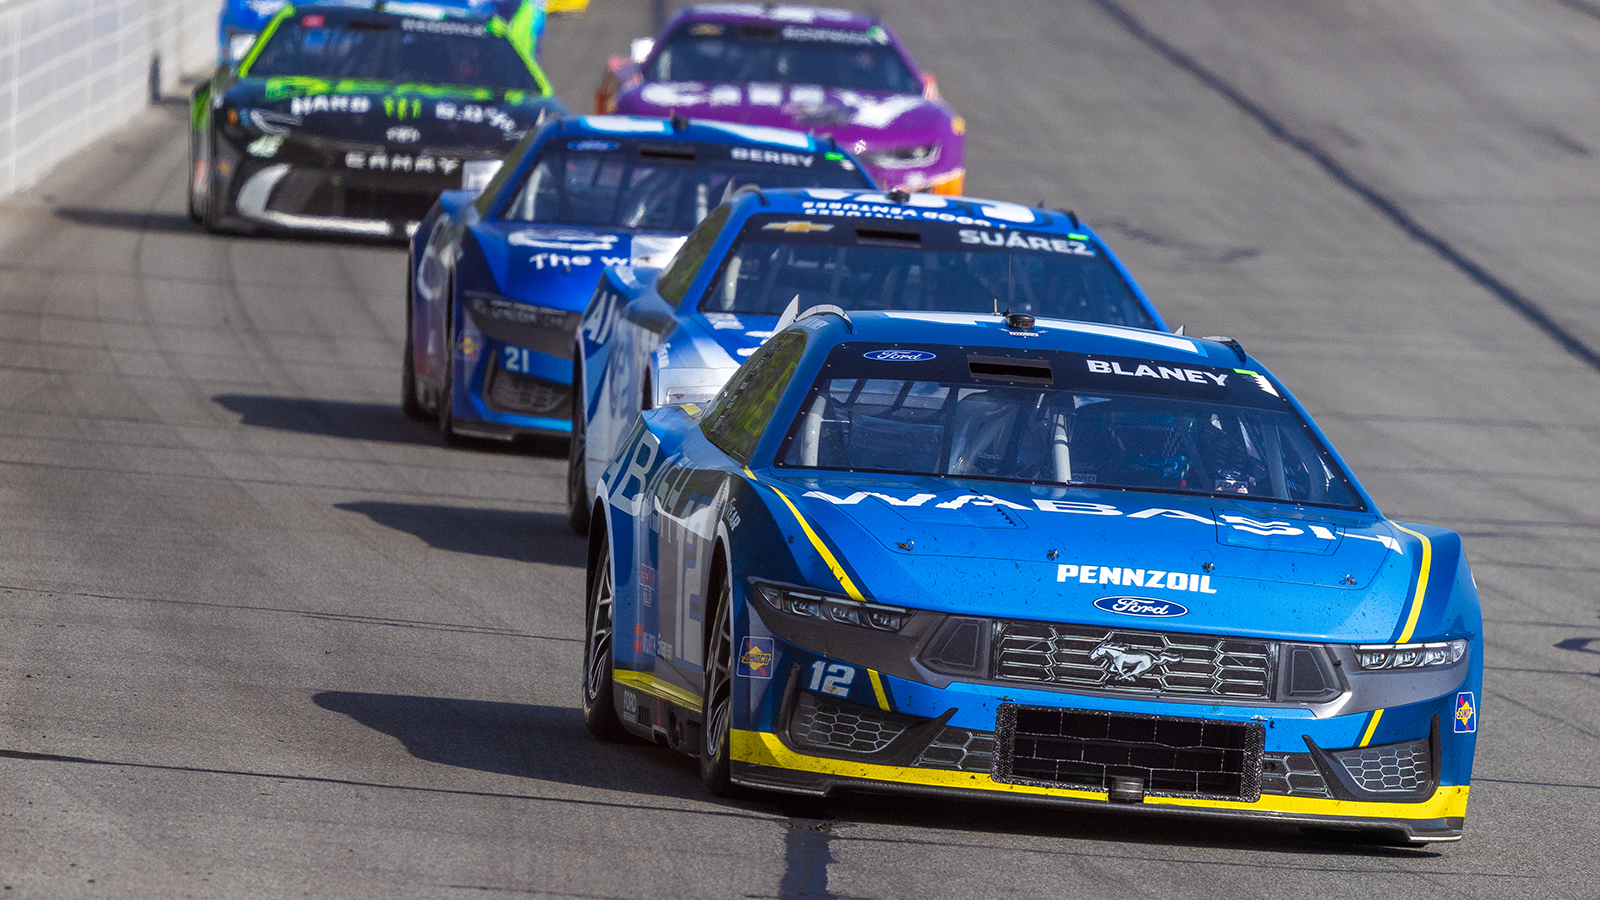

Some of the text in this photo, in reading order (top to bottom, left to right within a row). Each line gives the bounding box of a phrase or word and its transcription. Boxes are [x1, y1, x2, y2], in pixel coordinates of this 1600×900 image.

[731, 147, 814, 167] BERRY
[958, 229, 1096, 257] SUÁREZ
[504, 345, 529, 373] 21
[1086, 359, 1228, 386] BLANEY
[801, 491, 1403, 555] WABASH
[1056, 564, 1217, 594] PENNZOIL
[1112, 597, 1169, 616] Ford
[744, 653, 771, 664] SUNOCO
[808, 660, 856, 698] 12
